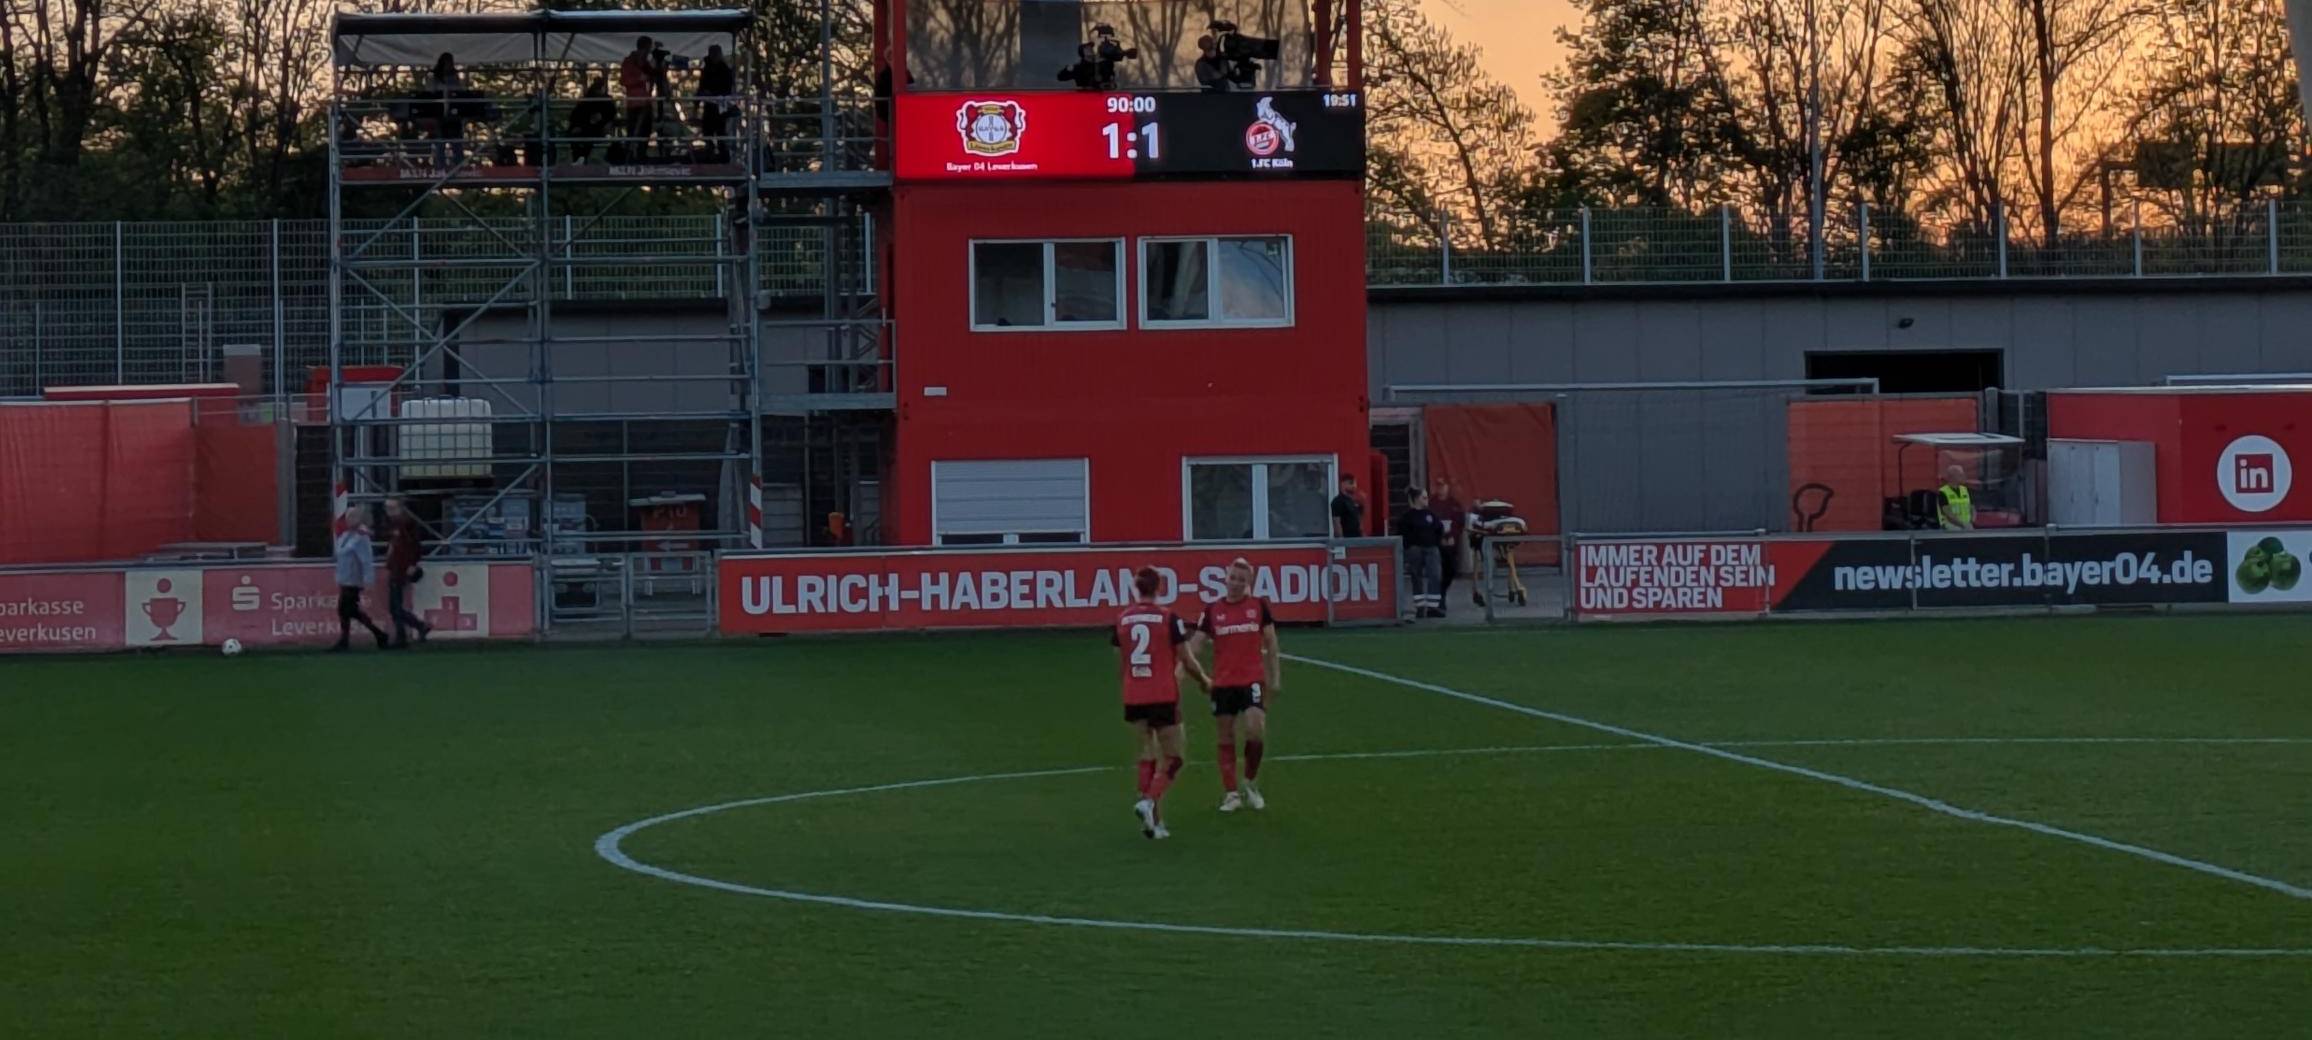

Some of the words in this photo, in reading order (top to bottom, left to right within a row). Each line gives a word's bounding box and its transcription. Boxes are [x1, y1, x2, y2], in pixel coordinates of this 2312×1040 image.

[1107, 96, 1156, 113] 90:00
[1323, 94, 1357, 107] 19:51
[1102, 122, 1159, 159] 1:1
[946, 162, 971, 173] Bayer
[974, 162, 985, 171] 04
[987, 160, 1038, 171] Leverkusen
[2240, 458, 2268, 489] in
[1580, 545, 1657, 566] IMMER
[1662, 545, 1706, 566] AUF
[1710, 544, 1761, 566] DEM
[1580, 565, 1715, 588] LAUFENDEN
[1719, 565, 1776, 588] SEIN
[1833, 550, 2213, 595] newsletter.bayer04.de
[741, 563, 1378, 614] ULRICH-HABERLAND-SADION
[1580, 587, 1628, 609] UND
[1632, 587, 1722, 609] SPAREN
[1131, 624, 1151, 664] 2
